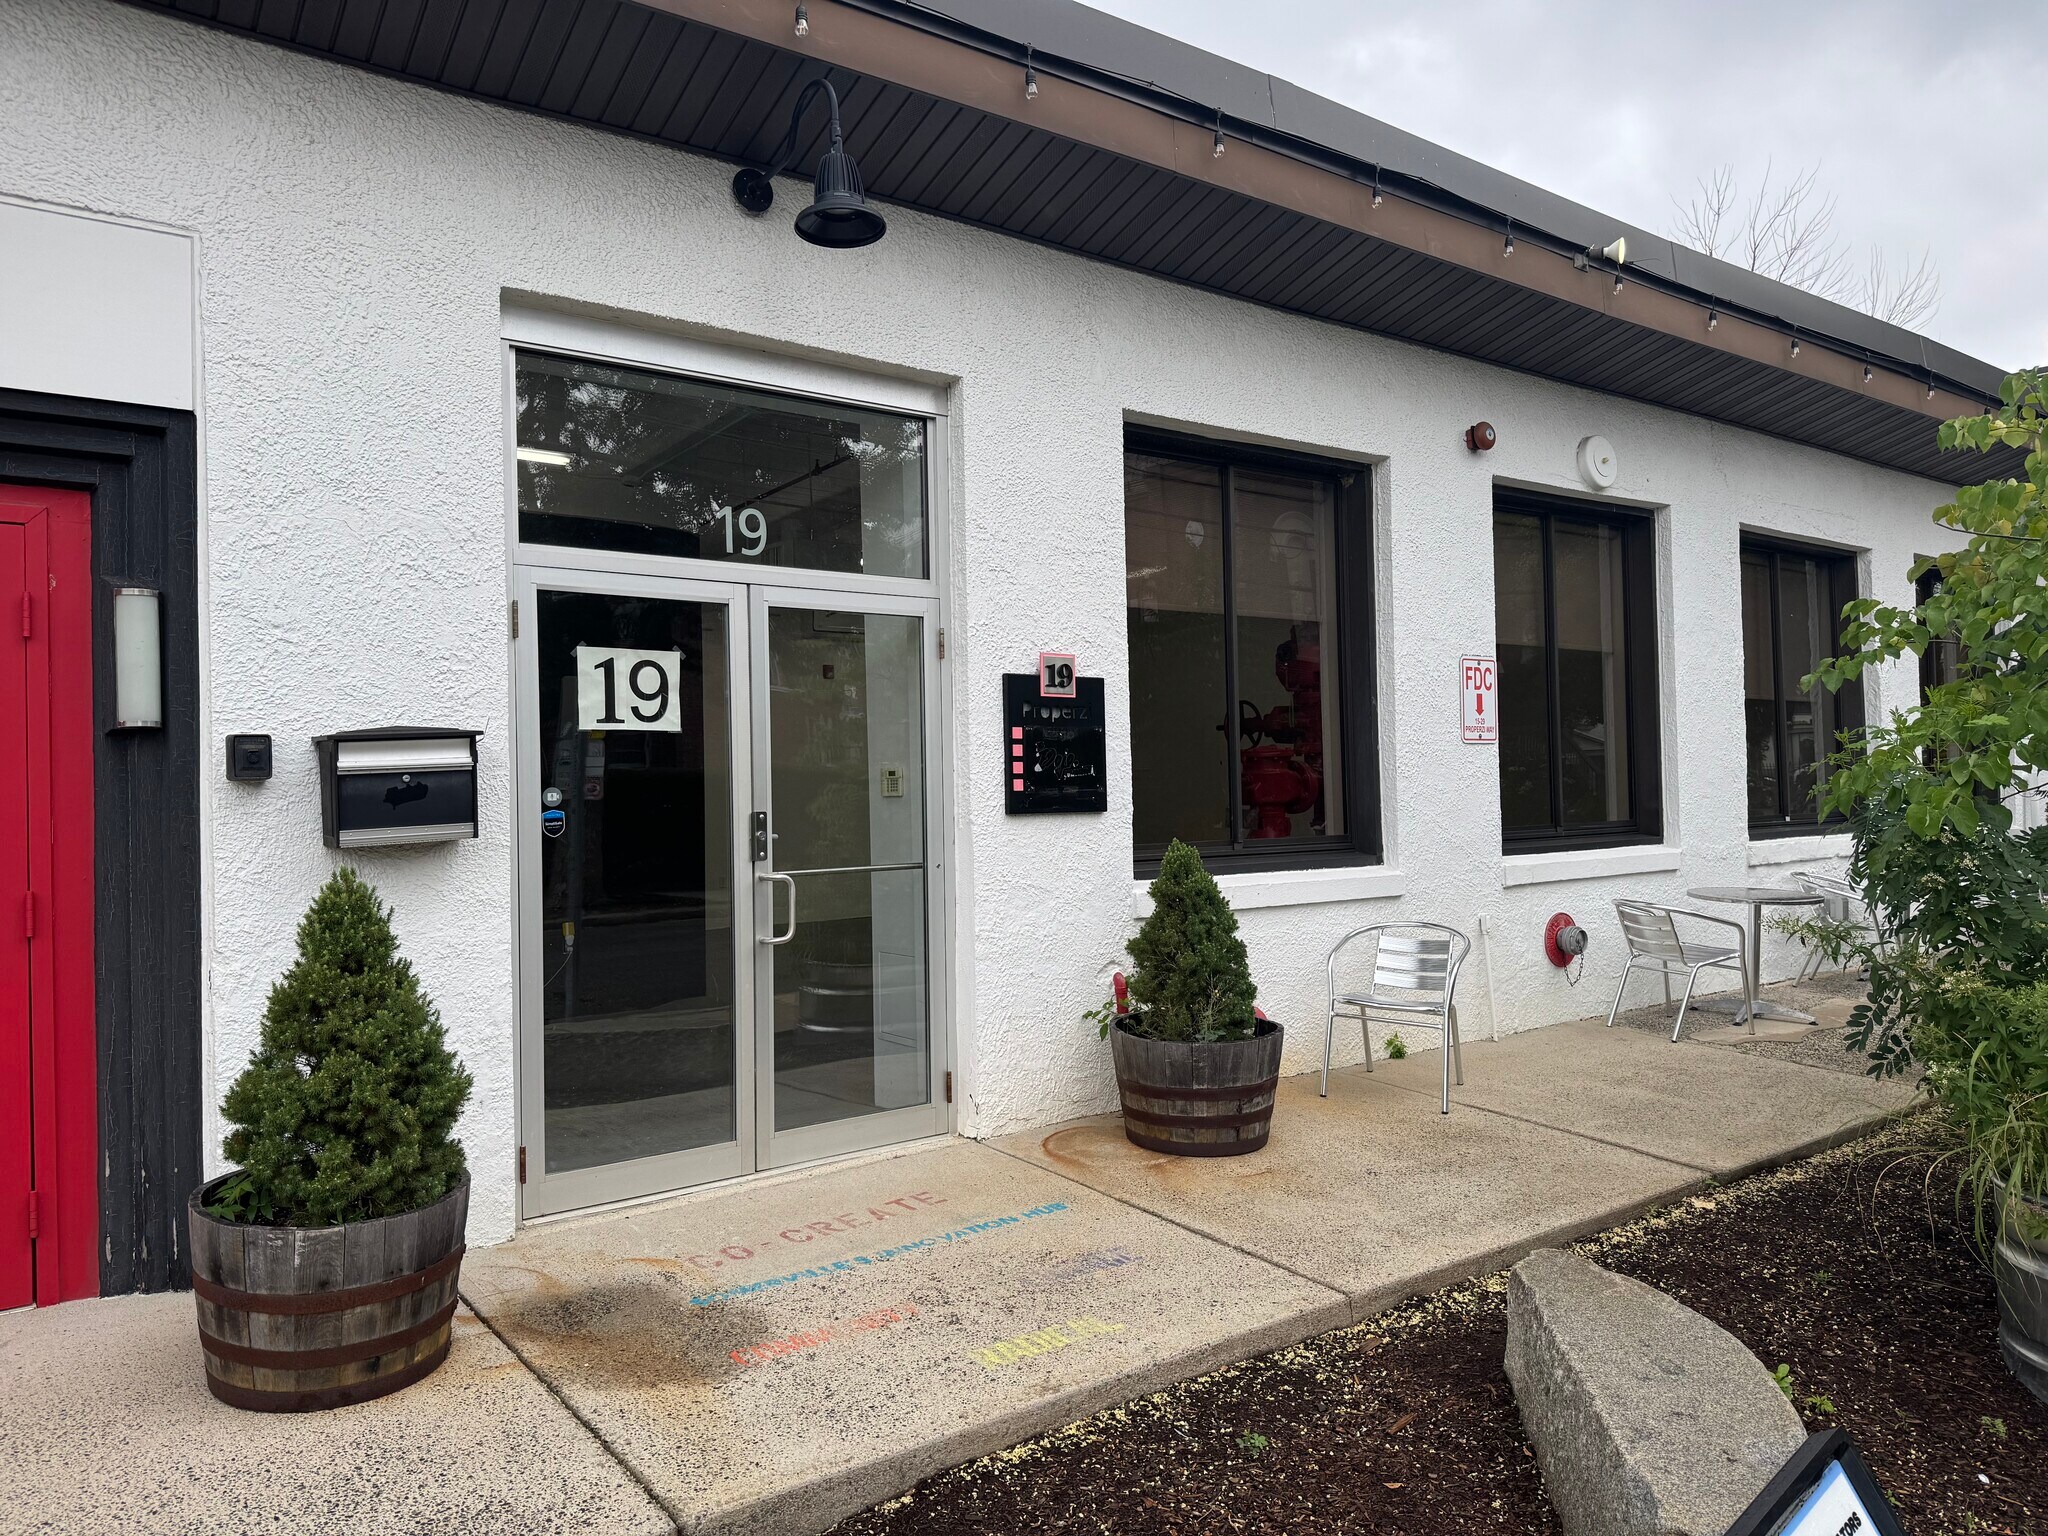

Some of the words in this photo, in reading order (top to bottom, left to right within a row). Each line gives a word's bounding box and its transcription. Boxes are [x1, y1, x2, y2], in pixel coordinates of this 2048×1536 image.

[716, 506, 767, 556] 19
[1045, 663, 1073, 688] 19
[1466, 667, 1492, 691] FDC
[594, 656, 669, 724] 19
[1022, 1201, 1069, 1219] HUB
[1835, 1511, 1862, 1536] TORS
